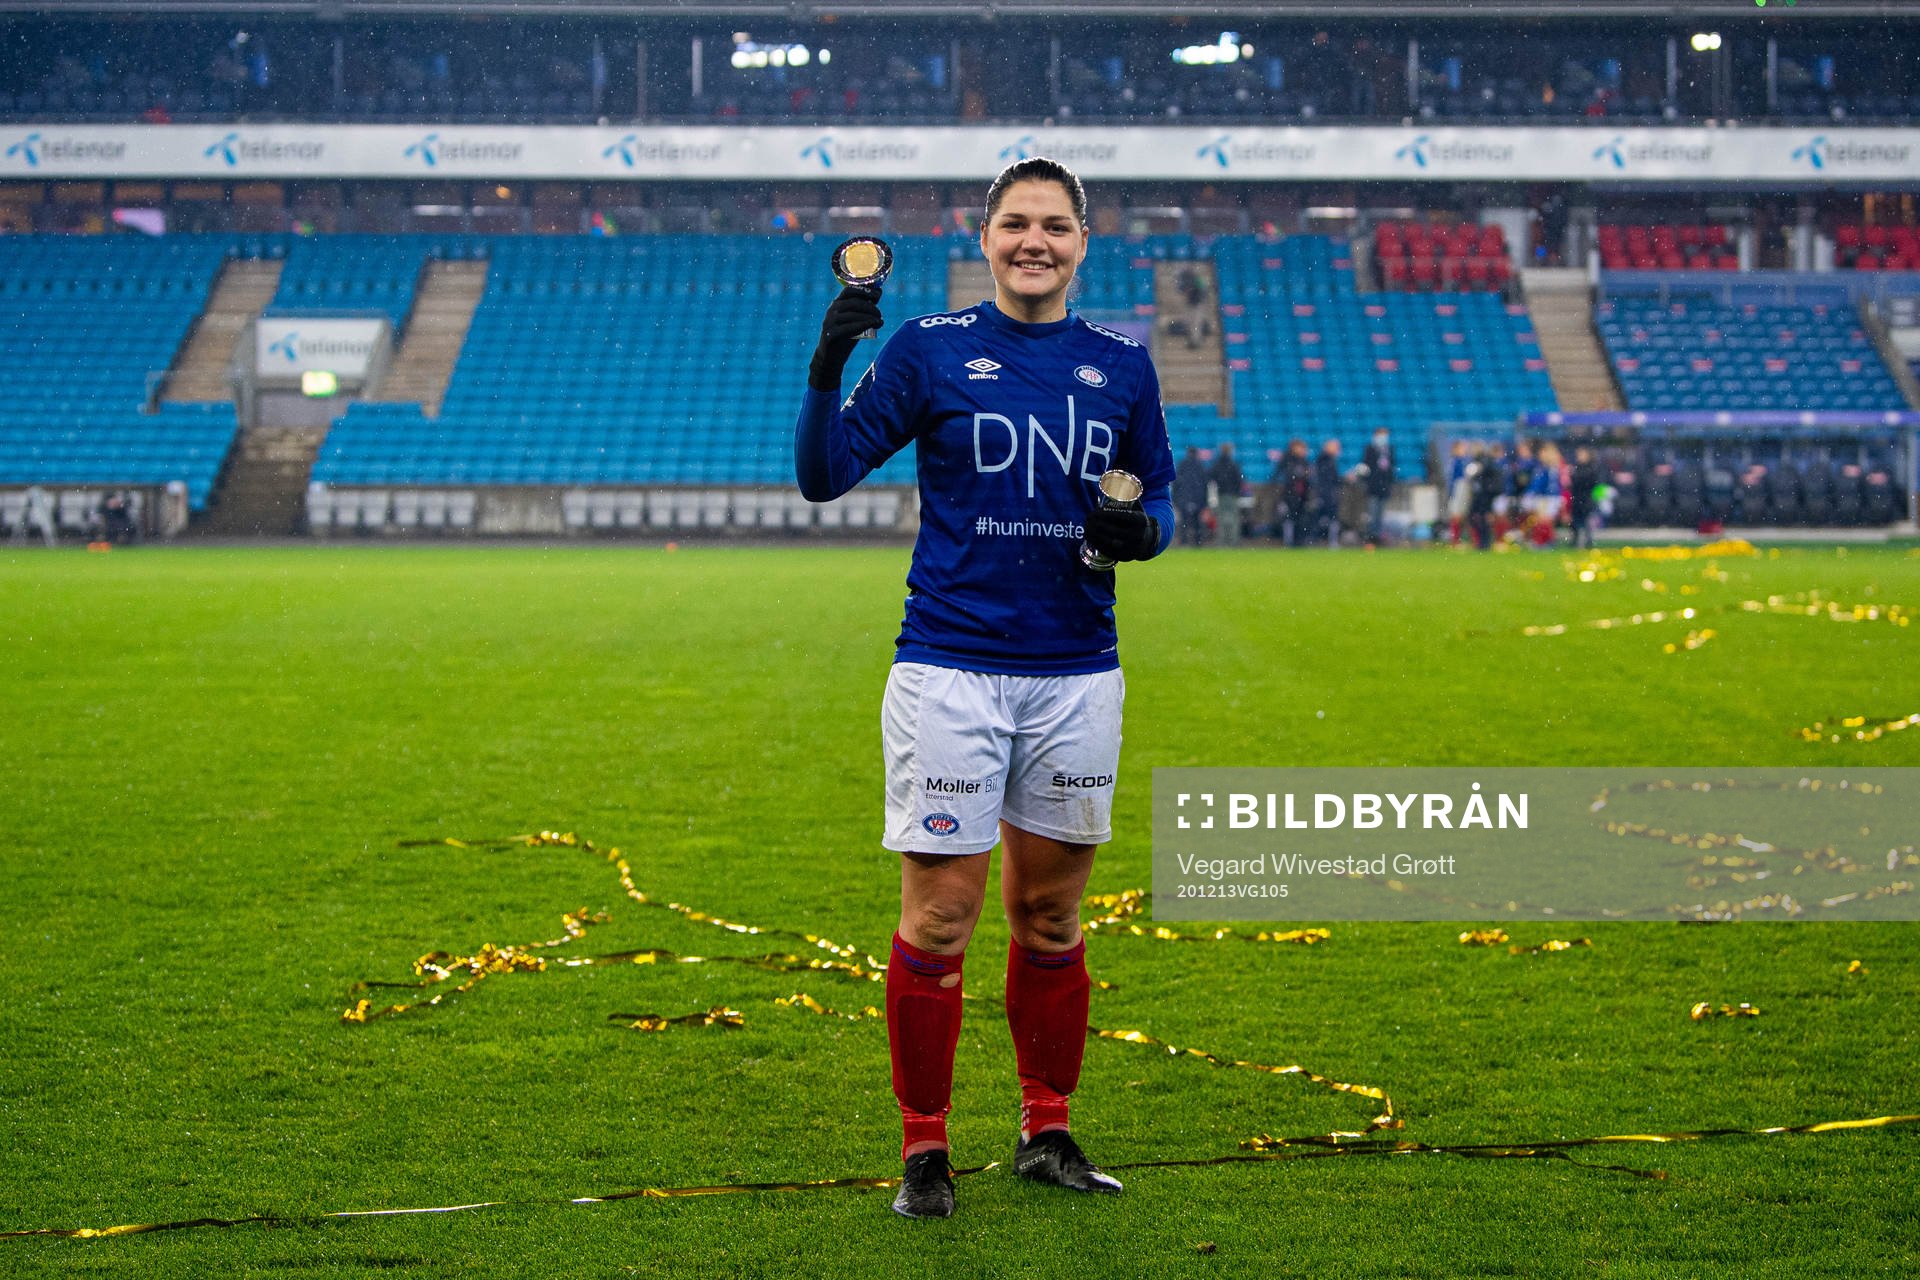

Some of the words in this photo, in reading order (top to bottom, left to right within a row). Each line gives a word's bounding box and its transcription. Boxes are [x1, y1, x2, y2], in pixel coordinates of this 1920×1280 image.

[41, 139, 126, 160] telenor
[239, 139, 324, 160] telenor
[438, 139, 522, 160] telenor
[636, 139, 721, 160] telenor
[1825, 140, 1910, 162] telenor
[920, 314, 977, 328] coop
[974, 395, 1112, 498] DNB
[1052, 772, 1113, 788] ŠKODA
